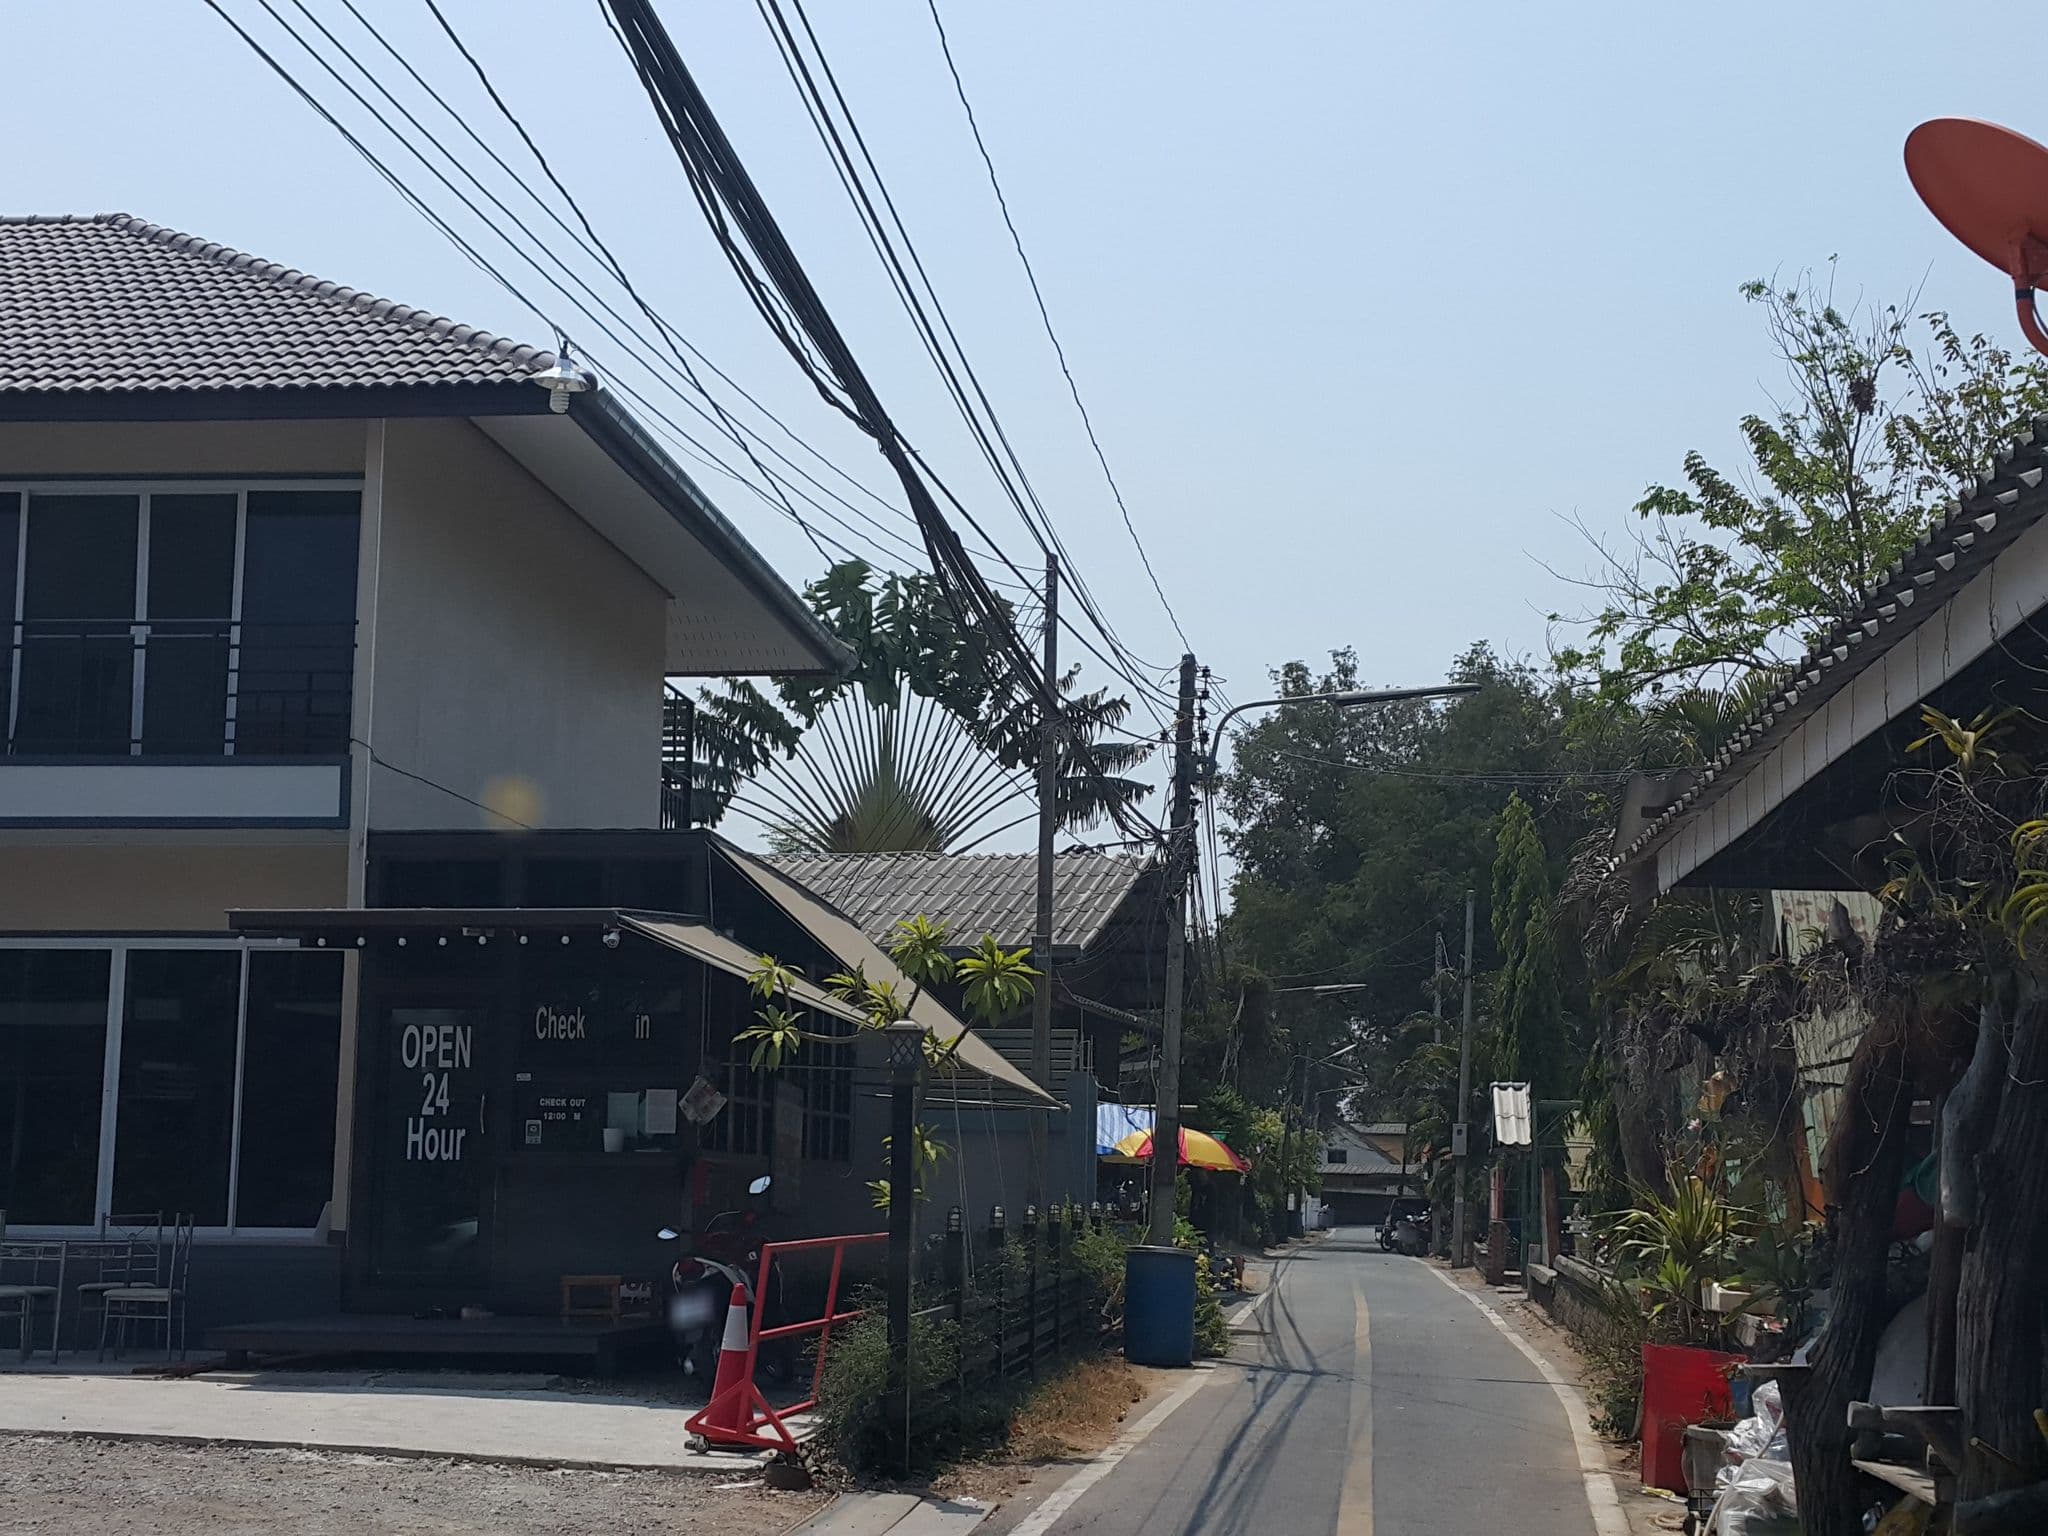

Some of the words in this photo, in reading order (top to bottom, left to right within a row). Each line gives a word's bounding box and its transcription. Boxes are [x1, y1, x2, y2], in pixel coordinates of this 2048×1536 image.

[535, 1006, 586, 1040] Check
[635, 1014, 650, 1039] in
[401, 1024, 472, 1069] OPEN
[421, 1072, 450, 1116] 24
[539, 1098, 567, 1107] CHECK
[569, 1098, 586, 1107] OUT
[543, 1111, 567, 1120] 12:00
[406, 1117, 466, 1161] Hour
